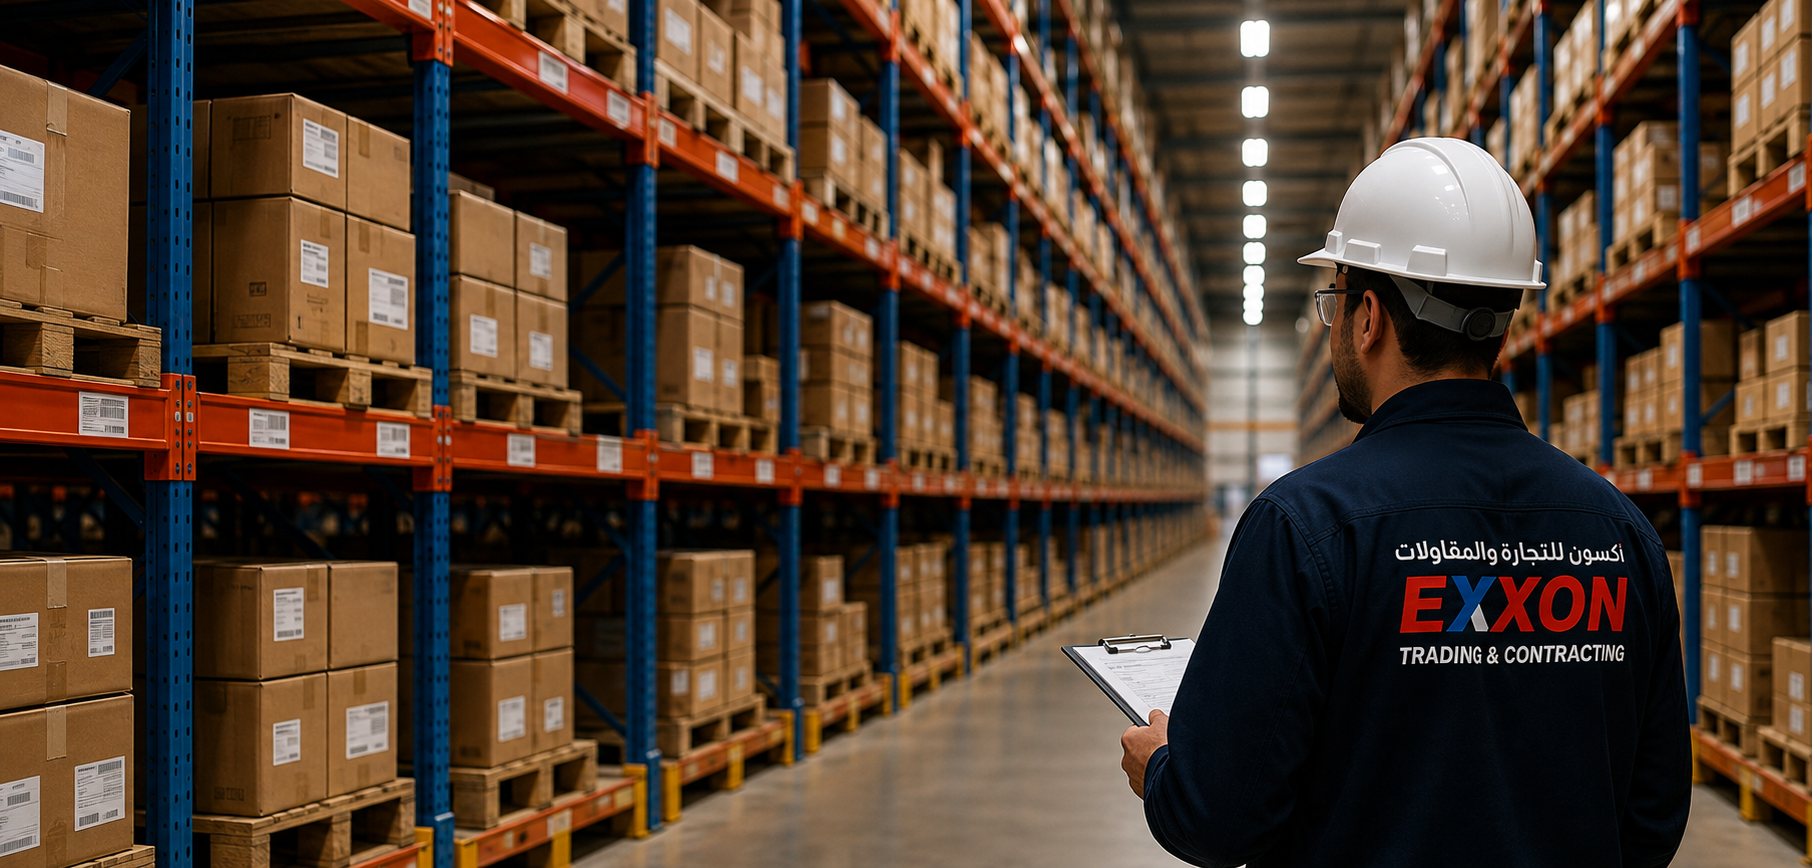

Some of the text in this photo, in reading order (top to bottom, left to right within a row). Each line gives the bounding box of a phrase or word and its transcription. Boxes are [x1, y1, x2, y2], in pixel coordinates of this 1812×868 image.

[1394, 539, 1625, 567] أكسون للتجارة والمقاولات
[1399, 574, 1628, 634] EXXON
[1399, 644, 1625, 665] TRADING & CONTRACTING
